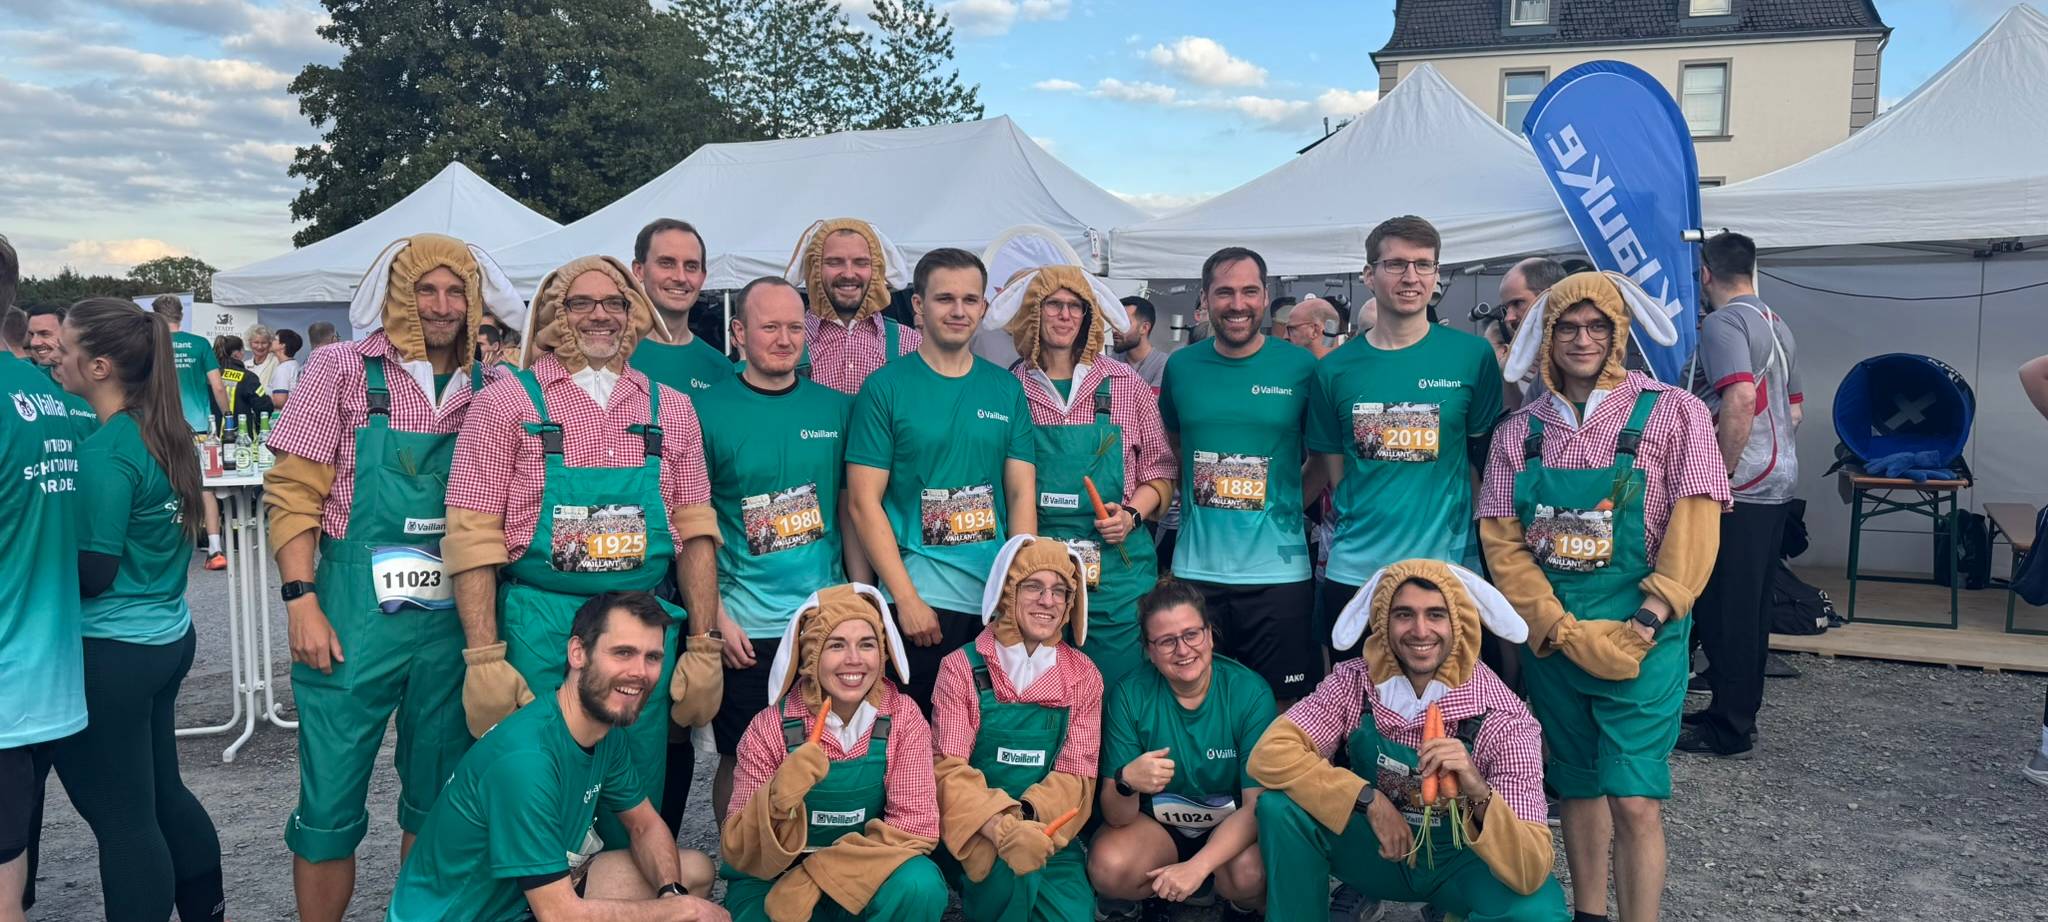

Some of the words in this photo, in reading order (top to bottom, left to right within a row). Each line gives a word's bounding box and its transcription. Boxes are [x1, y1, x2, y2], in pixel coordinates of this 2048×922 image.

[1427, 379, 1461, 388] Vaillant
[1260, 386, 1293, 396] Vaillant
[808, 430, 838, 438] Vaillant
[1386, 429, 1437, 447] 2019
[1220, 478, 1264, 497] 1882
[1050, 496, 1077, 506] Vaillant
[780, 509, 821, 534] 1980
[955, 509, 995, 530] 1934
[417, 522, 446, 532] Vaillan
[594, 534, 645, 556] 1925
[1560, 535, 1610, 557] 1992
[383, 570, 441, 589] 11023
[1284, 673, 1305, 684] JAKO
[1010, 752, 1041, 764] Vaillant
[826, 812, 860, 825] Vaillant
[1162, 811, 1213, 823] 11024
